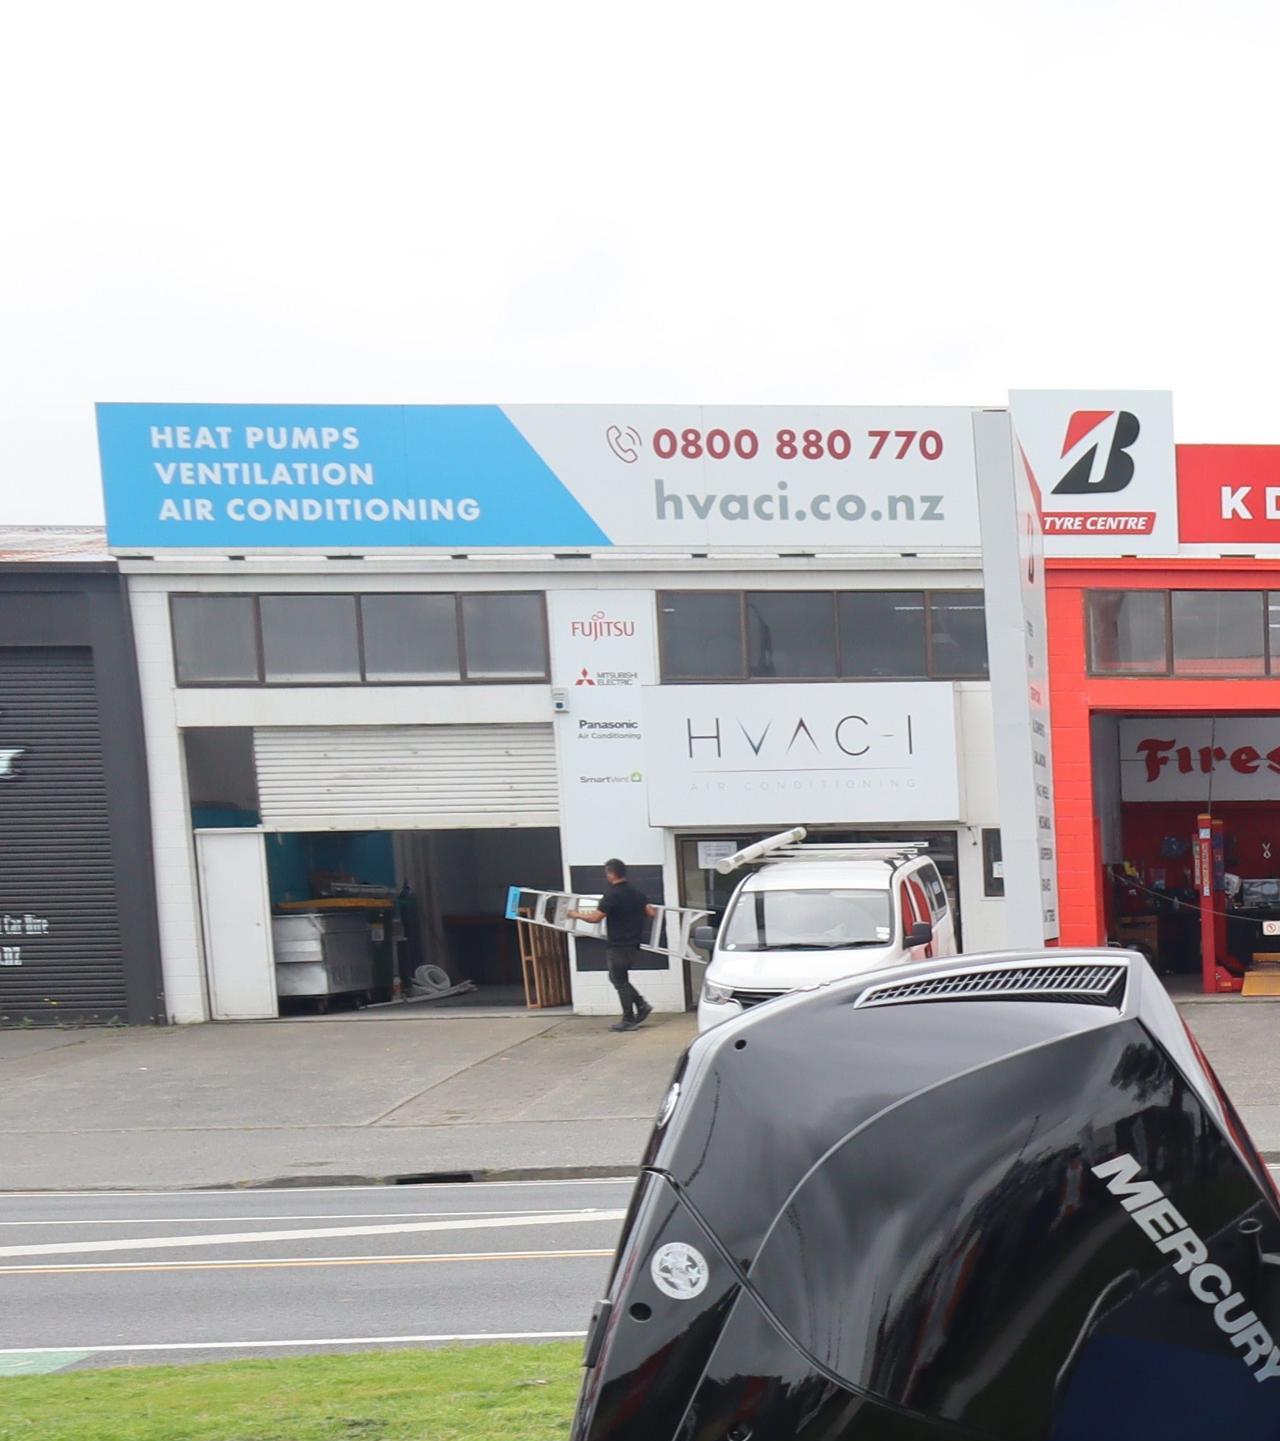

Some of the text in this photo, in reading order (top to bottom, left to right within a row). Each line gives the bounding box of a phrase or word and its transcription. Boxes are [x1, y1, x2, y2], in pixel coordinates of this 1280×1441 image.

[150, 426, 360, 450] HEAT PUMPS
[653, 428, 944, 461] 0800 880 770
[154, 462, 374, 486] VENTILATION
[159, 498, 481, 522] AIR CONDITIONING
[655, 479, 945, 522] hvaci.co.nz
[1221, 486, 1253, 520] K
[1043, 516, 1148, 530] TYRE CENTRE
[571, 619, 635, 641] FUJITSU
[579, 719, 639, 730] Panasonic
[578, 732, 642, 741] Air Conditioning
[579, 775, 630, 784] SmartVent
[690, 778, 917, 792] AIR CONDITIONING
